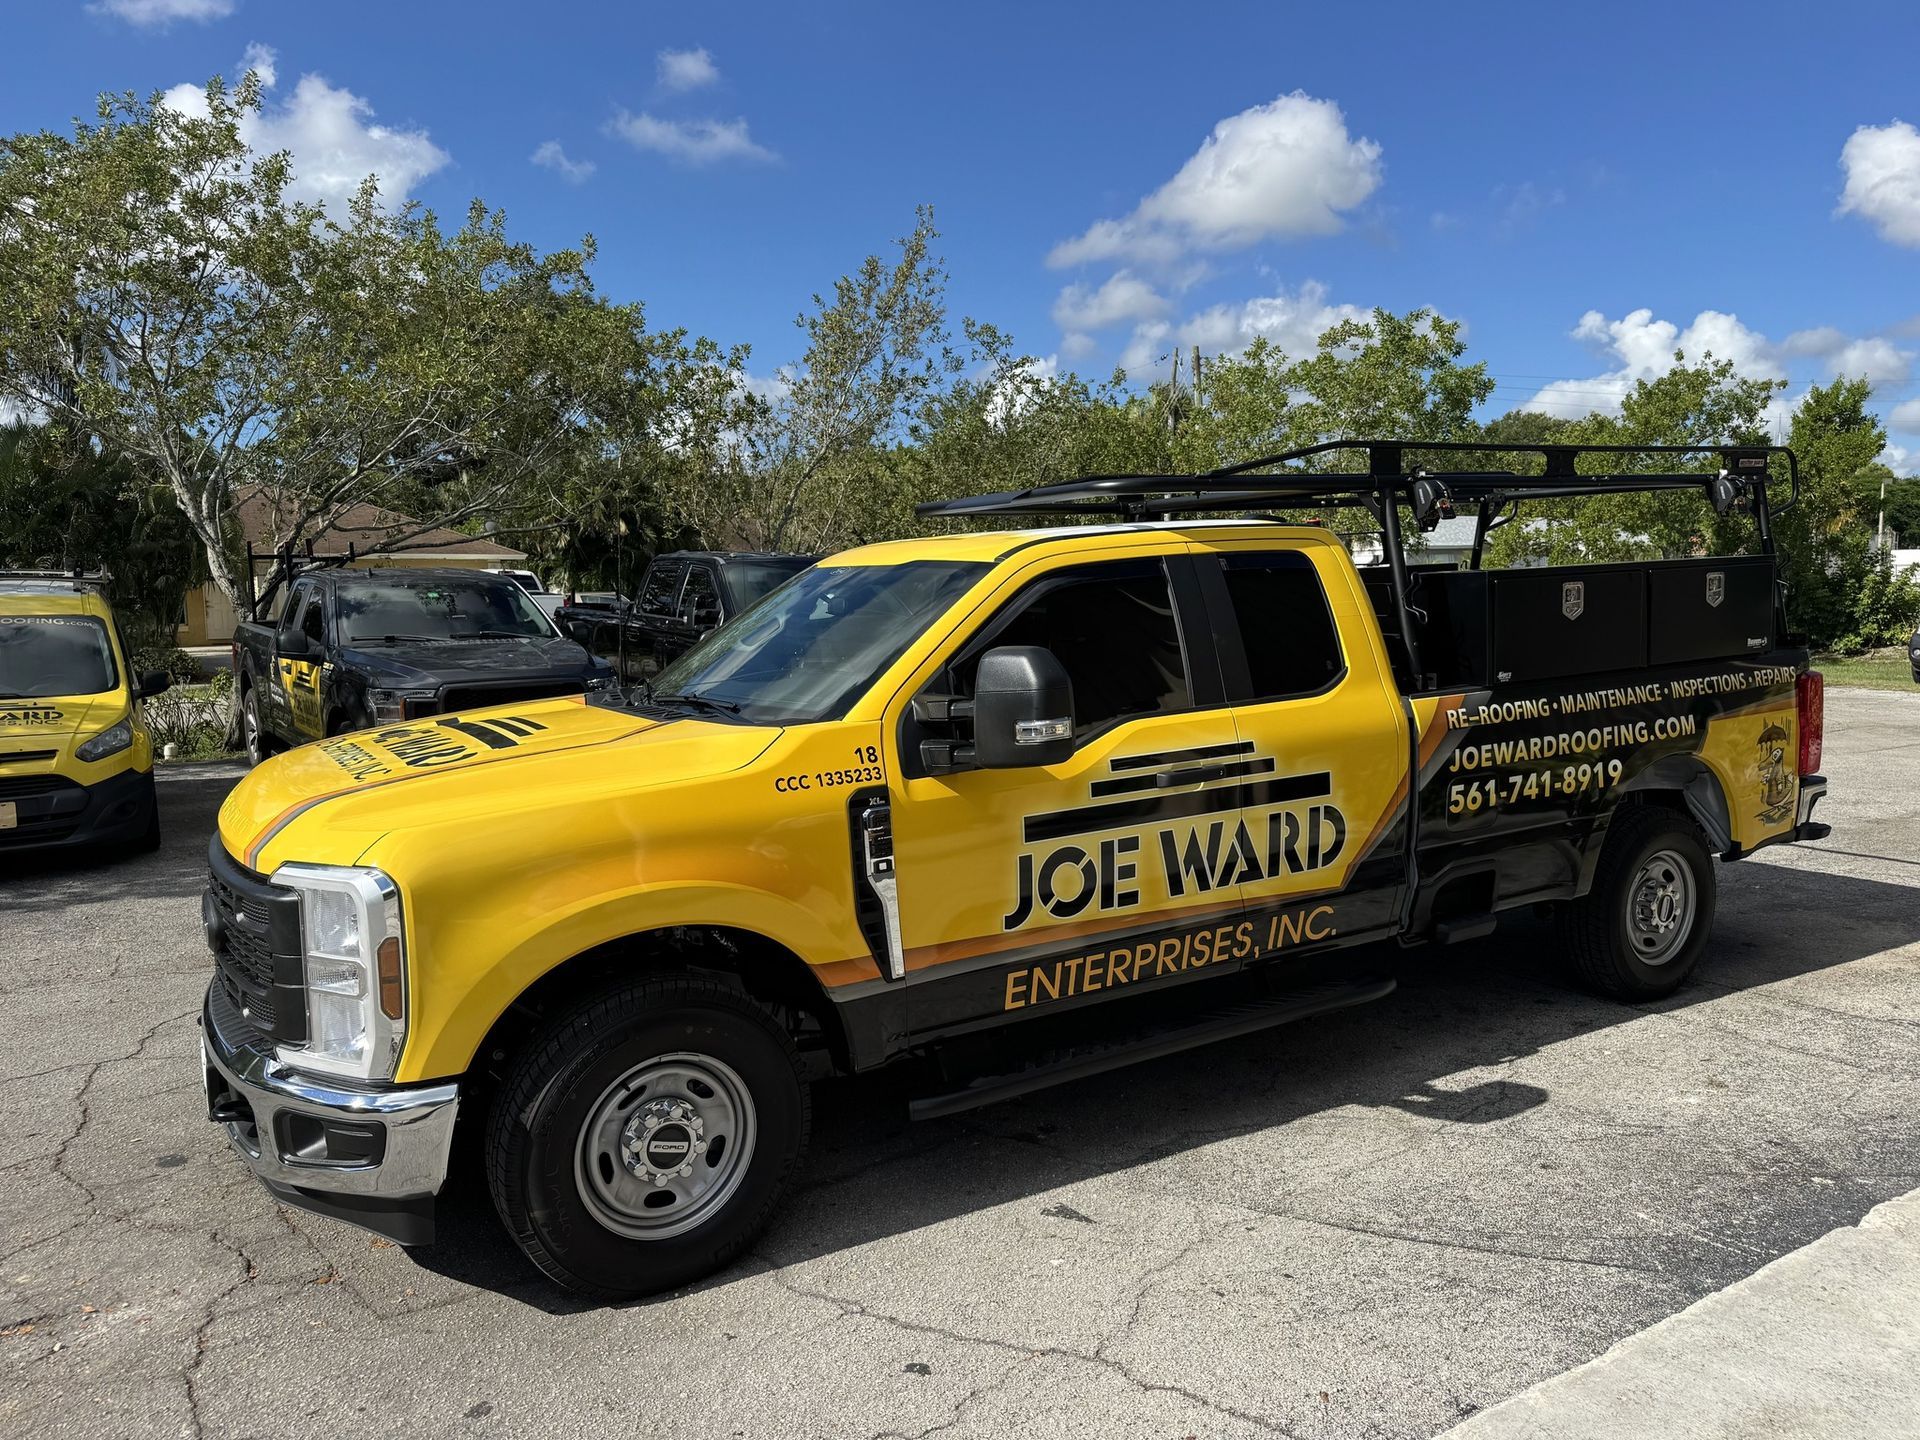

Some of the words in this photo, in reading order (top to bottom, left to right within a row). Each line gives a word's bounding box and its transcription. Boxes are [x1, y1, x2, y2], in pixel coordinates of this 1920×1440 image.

[1447, 699, 1550, 730] RE-ROOFING
[1560, 683, 1663, 714] MAINTENANCE
[1671, 669, 1747, 699] INSPECTIONS
[1754, 665, 1797, 686] REPAIRS
[854, 745, 878, 765] 18
[1449, 714, 1697, 774] JOEWARDROOFING.COM
[775, 775, 811, 792] CCC
[815, 766, 882, 788] 1335233
[1448, 758, 1624, 814] 561-741-8919
[1002, 834, 1141, 932] JOE
[1159, 803, 1347, 898] WARD
[1004, 922, 1260, 1011] ENTERPRISES,
[1267, 905, 1338, 950] INC.
[653, 1143, 686, 1151] FORD
